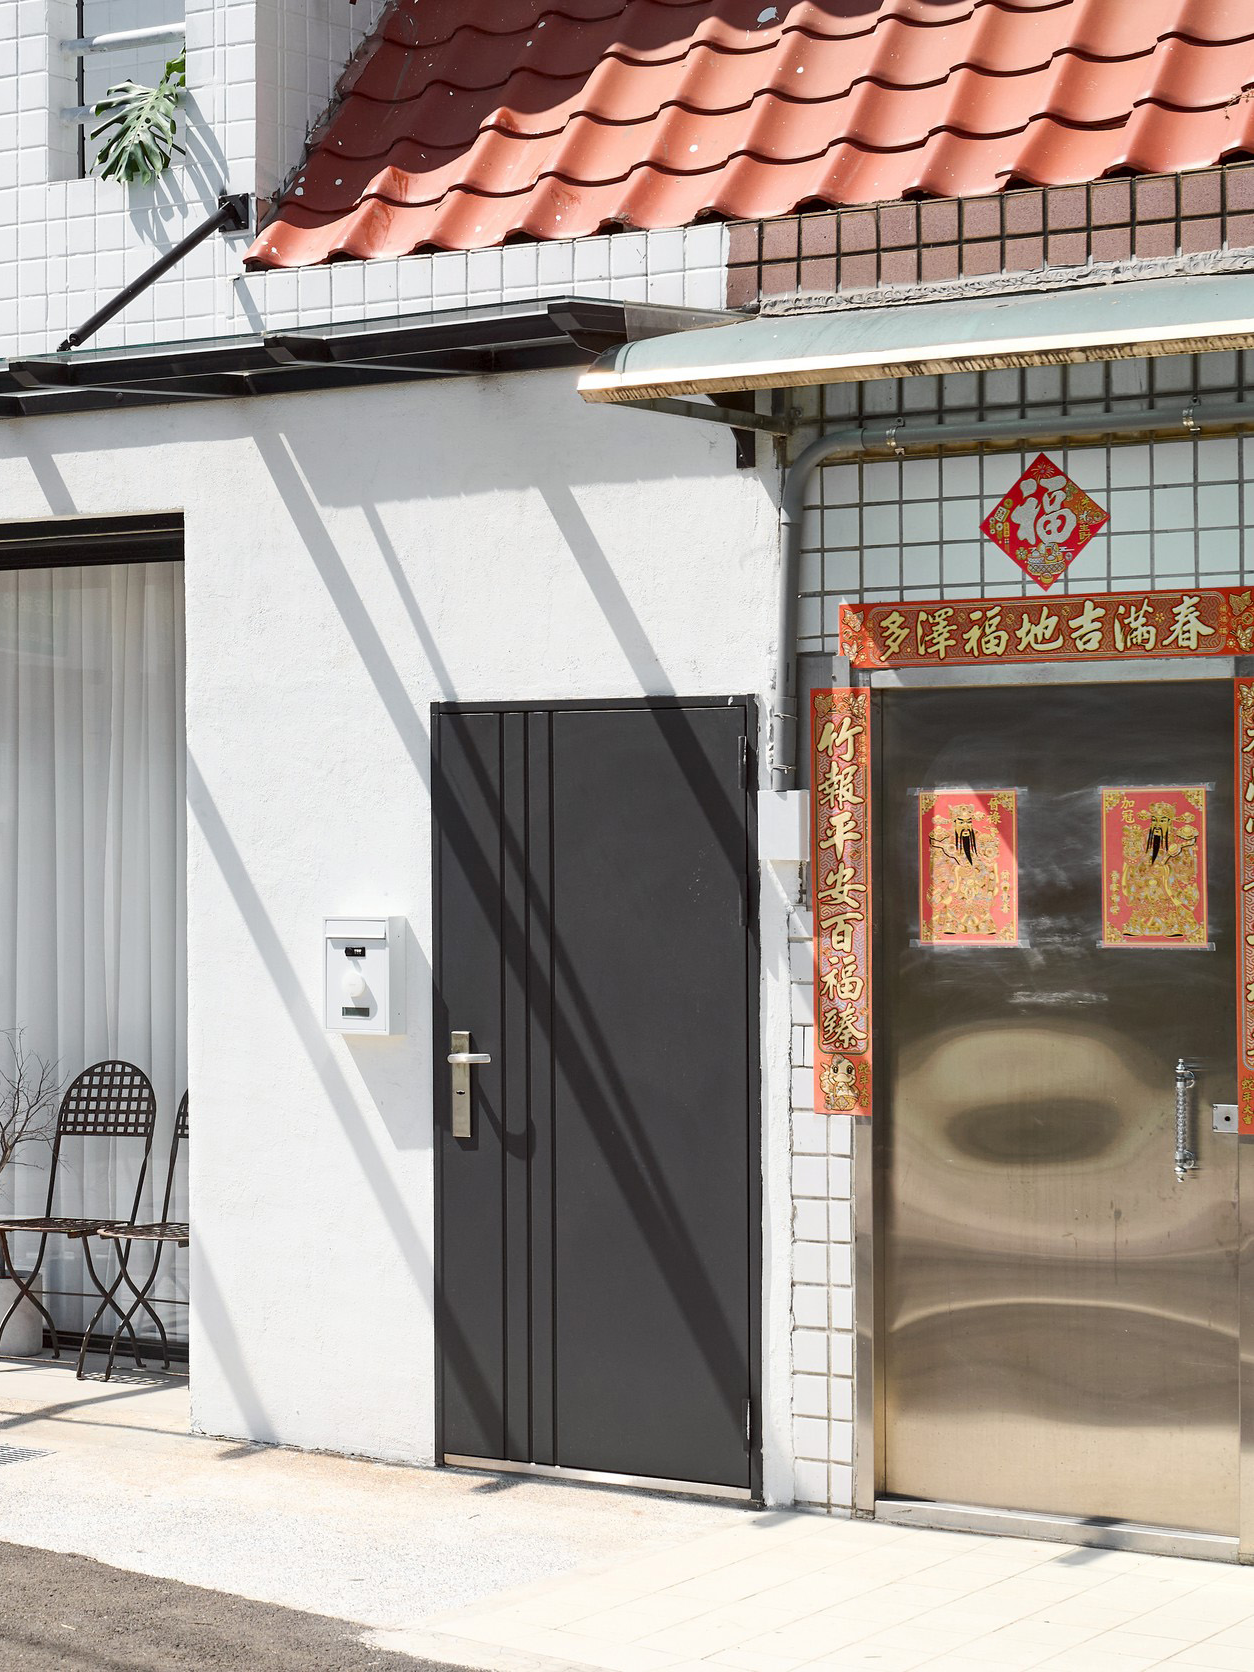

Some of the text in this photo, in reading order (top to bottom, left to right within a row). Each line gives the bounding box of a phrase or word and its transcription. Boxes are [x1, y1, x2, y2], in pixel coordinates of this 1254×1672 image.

[1010, 475, 1077, 545] 福
[817, 717, 868, 1048] 竹報平安百福臻
